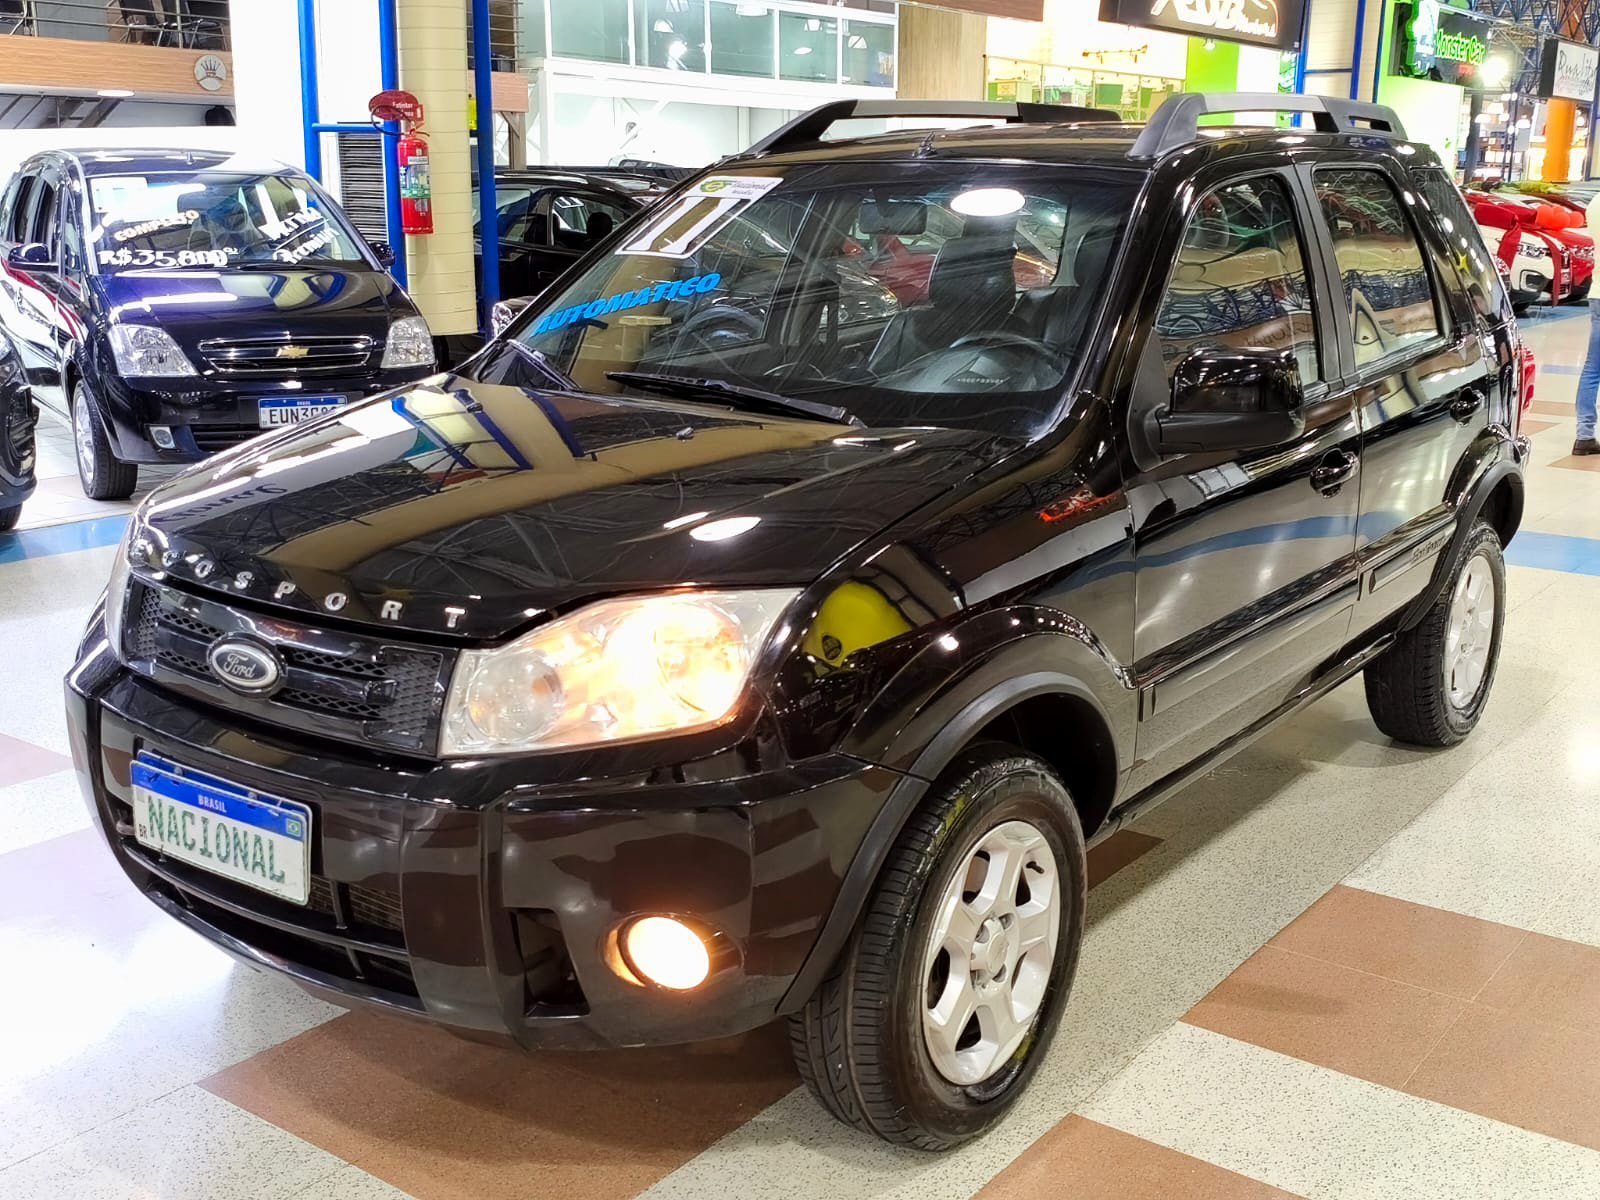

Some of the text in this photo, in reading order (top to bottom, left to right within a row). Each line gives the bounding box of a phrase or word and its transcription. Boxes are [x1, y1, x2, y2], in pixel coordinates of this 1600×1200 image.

[531, 272, 721, 338] AUTOMATICO
[223, 653, 257, 679] Ford
[197, 794, 227, 813] BRASIL
[139, 823, 148, 839] BR
[147, 795, 286, 883] NACIONAL
